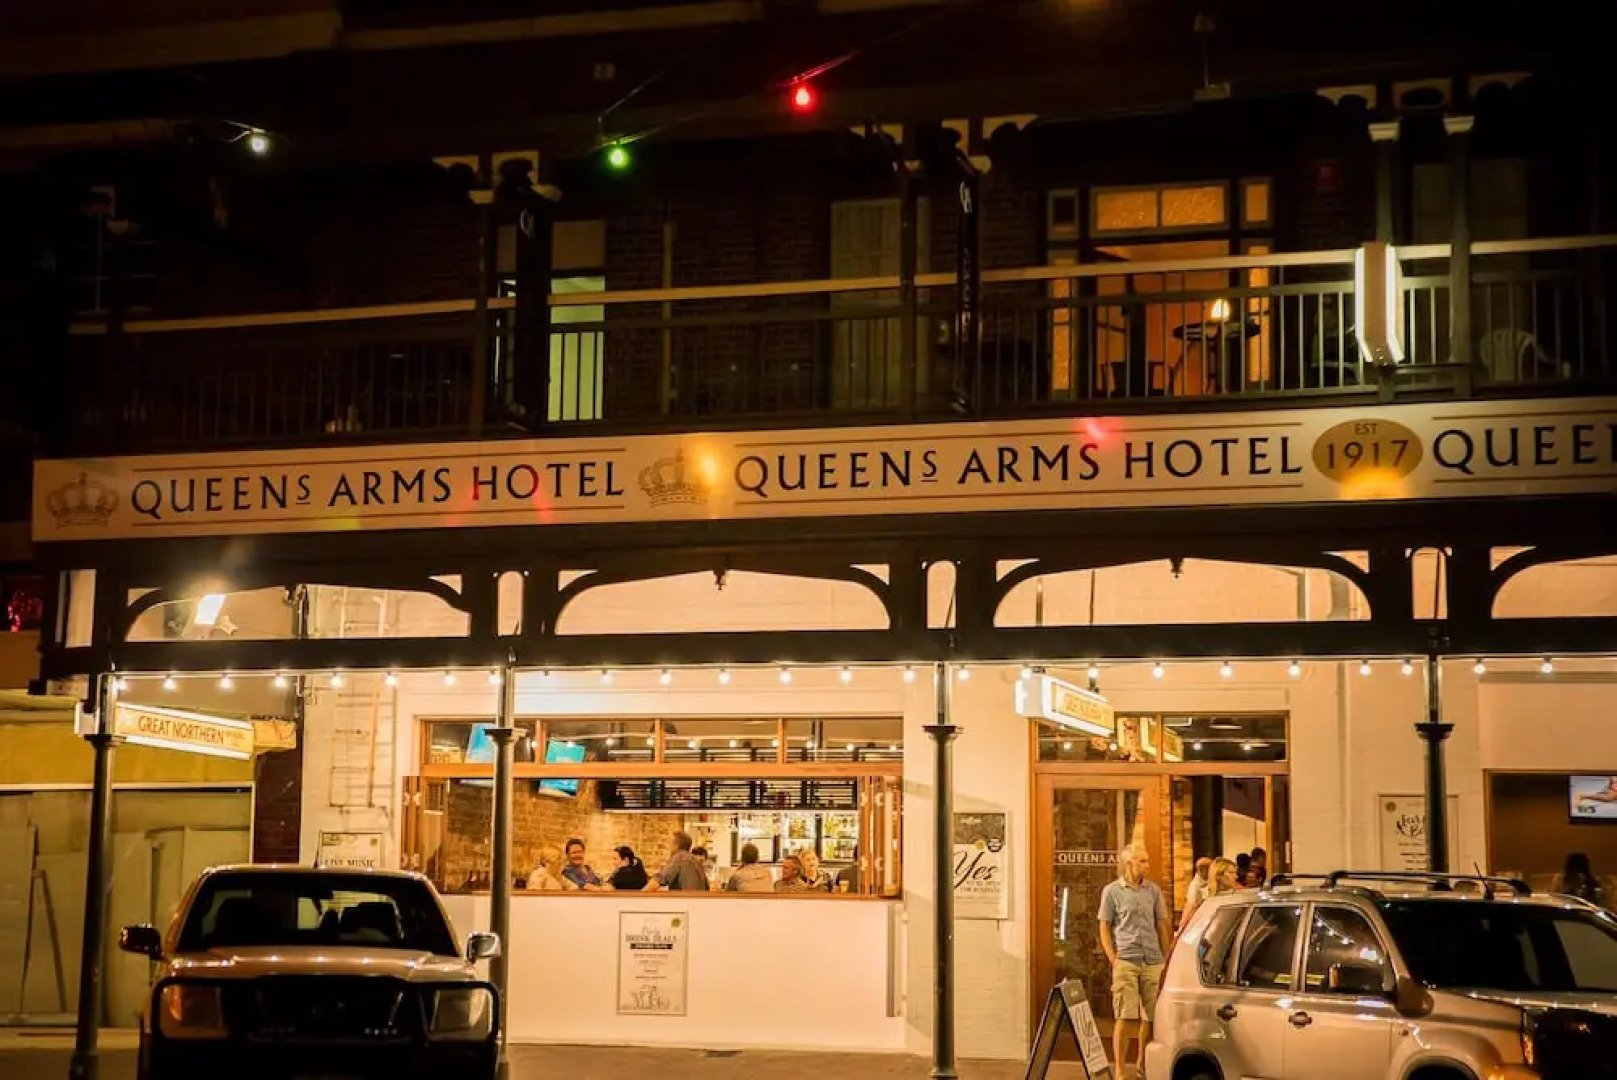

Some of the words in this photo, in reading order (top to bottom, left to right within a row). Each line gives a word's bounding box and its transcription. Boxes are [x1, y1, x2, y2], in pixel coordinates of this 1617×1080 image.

[1355, 423, 1377, 435] EST
[957, 443, 1100, 484] ARMS
[1124, 436, 1303, 479] HOTEL
[1326, 440, 1408, 470] 1917
[1433, 423, 1617, 475] QUEE
[328, 467, 451, 507] ARMS
[473, 461, 624, 501] HOTEL
[138, 716, 170, 735] GREAT
[172, 721, 224, 744] NORTHERN
[954, 851, 998, 888] Yes
